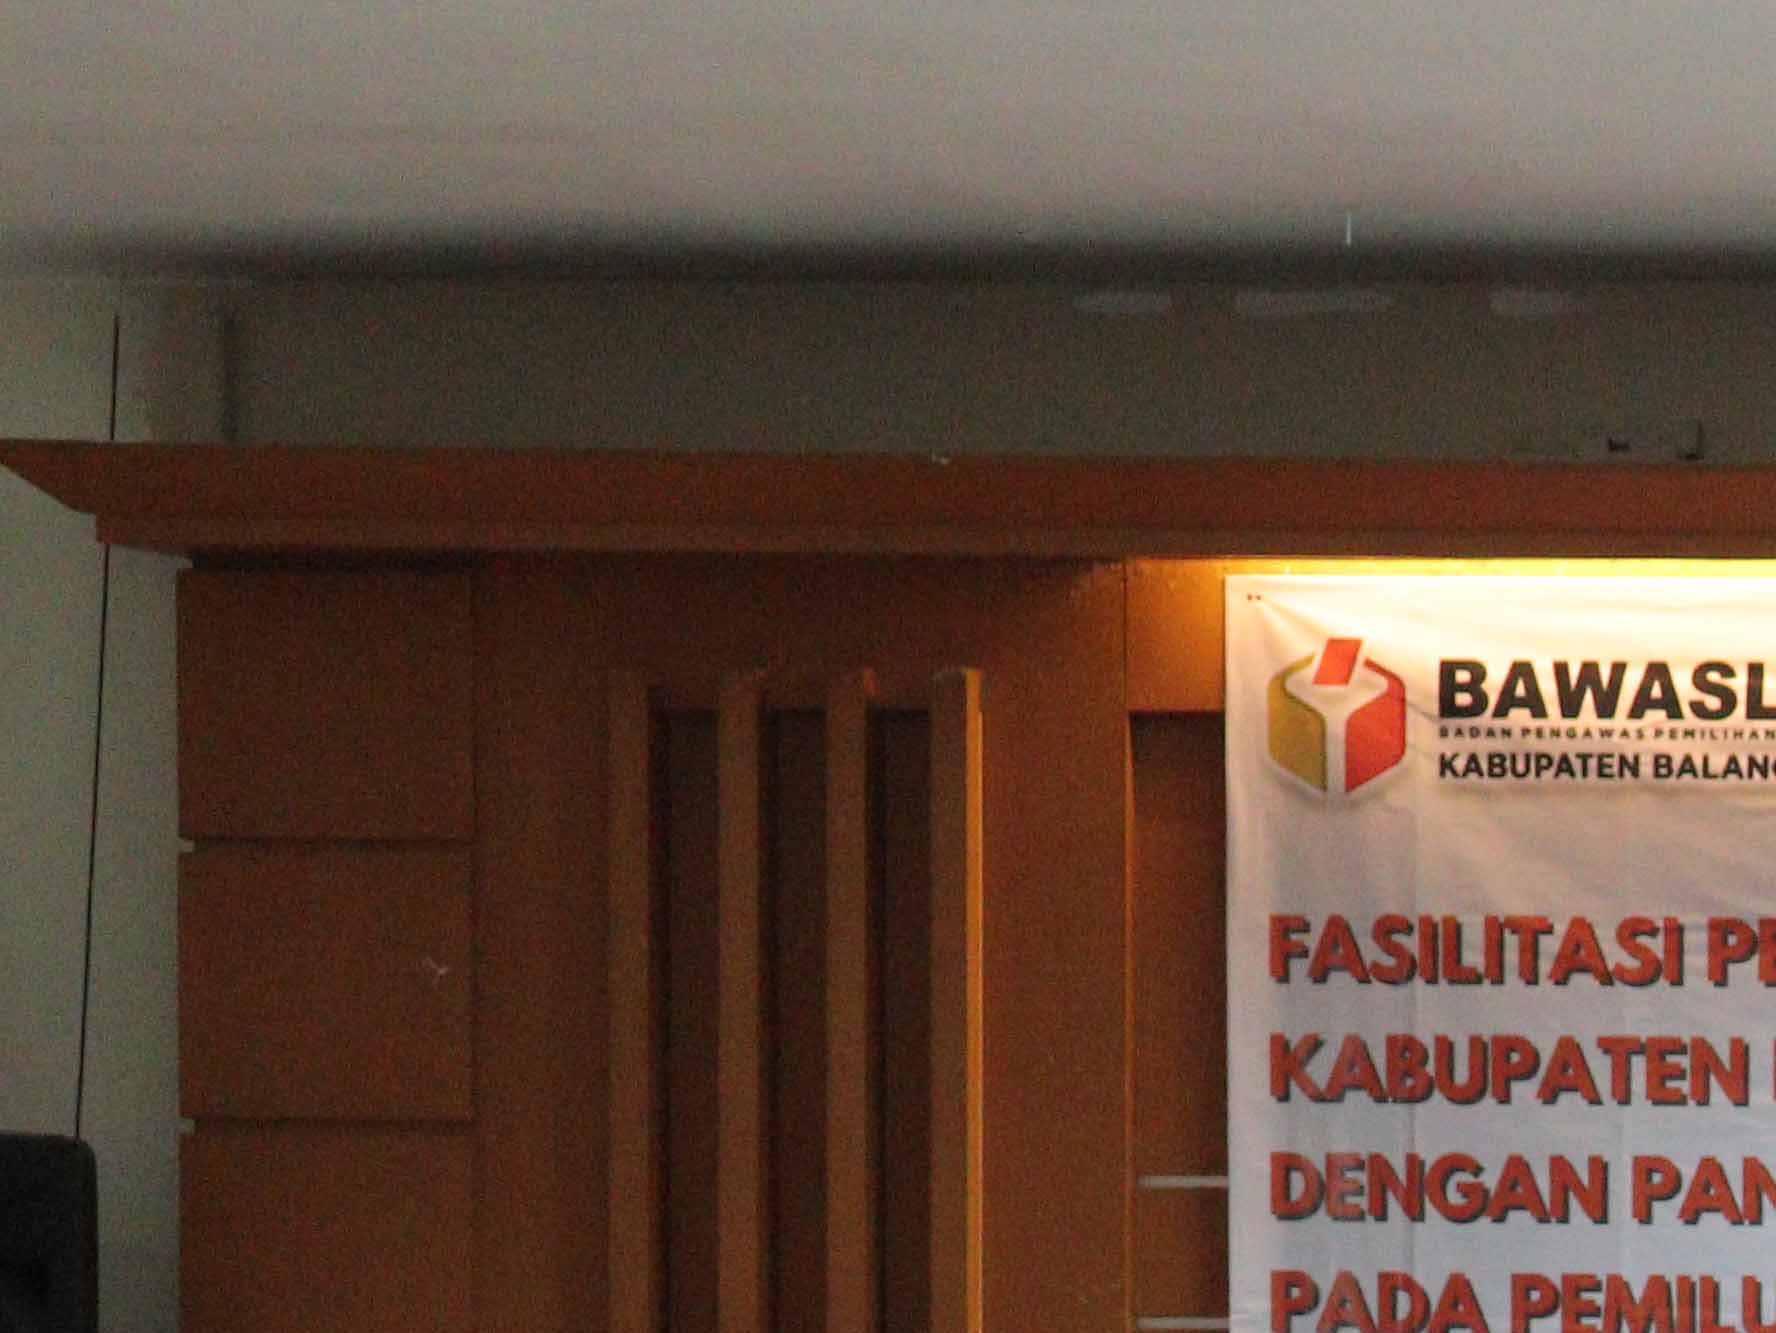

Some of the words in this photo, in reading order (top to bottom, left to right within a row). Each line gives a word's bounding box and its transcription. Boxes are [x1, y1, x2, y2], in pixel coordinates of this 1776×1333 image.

[1438, 752, 1640, 780] KABUPATEN
[1439, 726, 1512, 740] BADAN
[1520, 727, 1646, 741] PENGAWAS
[1653, 727, 1776, 742] PEMILIHAN
[1268, 913, 1684, 986] FASILITASI
[1269, 1033, 1749, 1105] KABUPATEN
[1269, 1152, 1608, 1223] DENGAN
